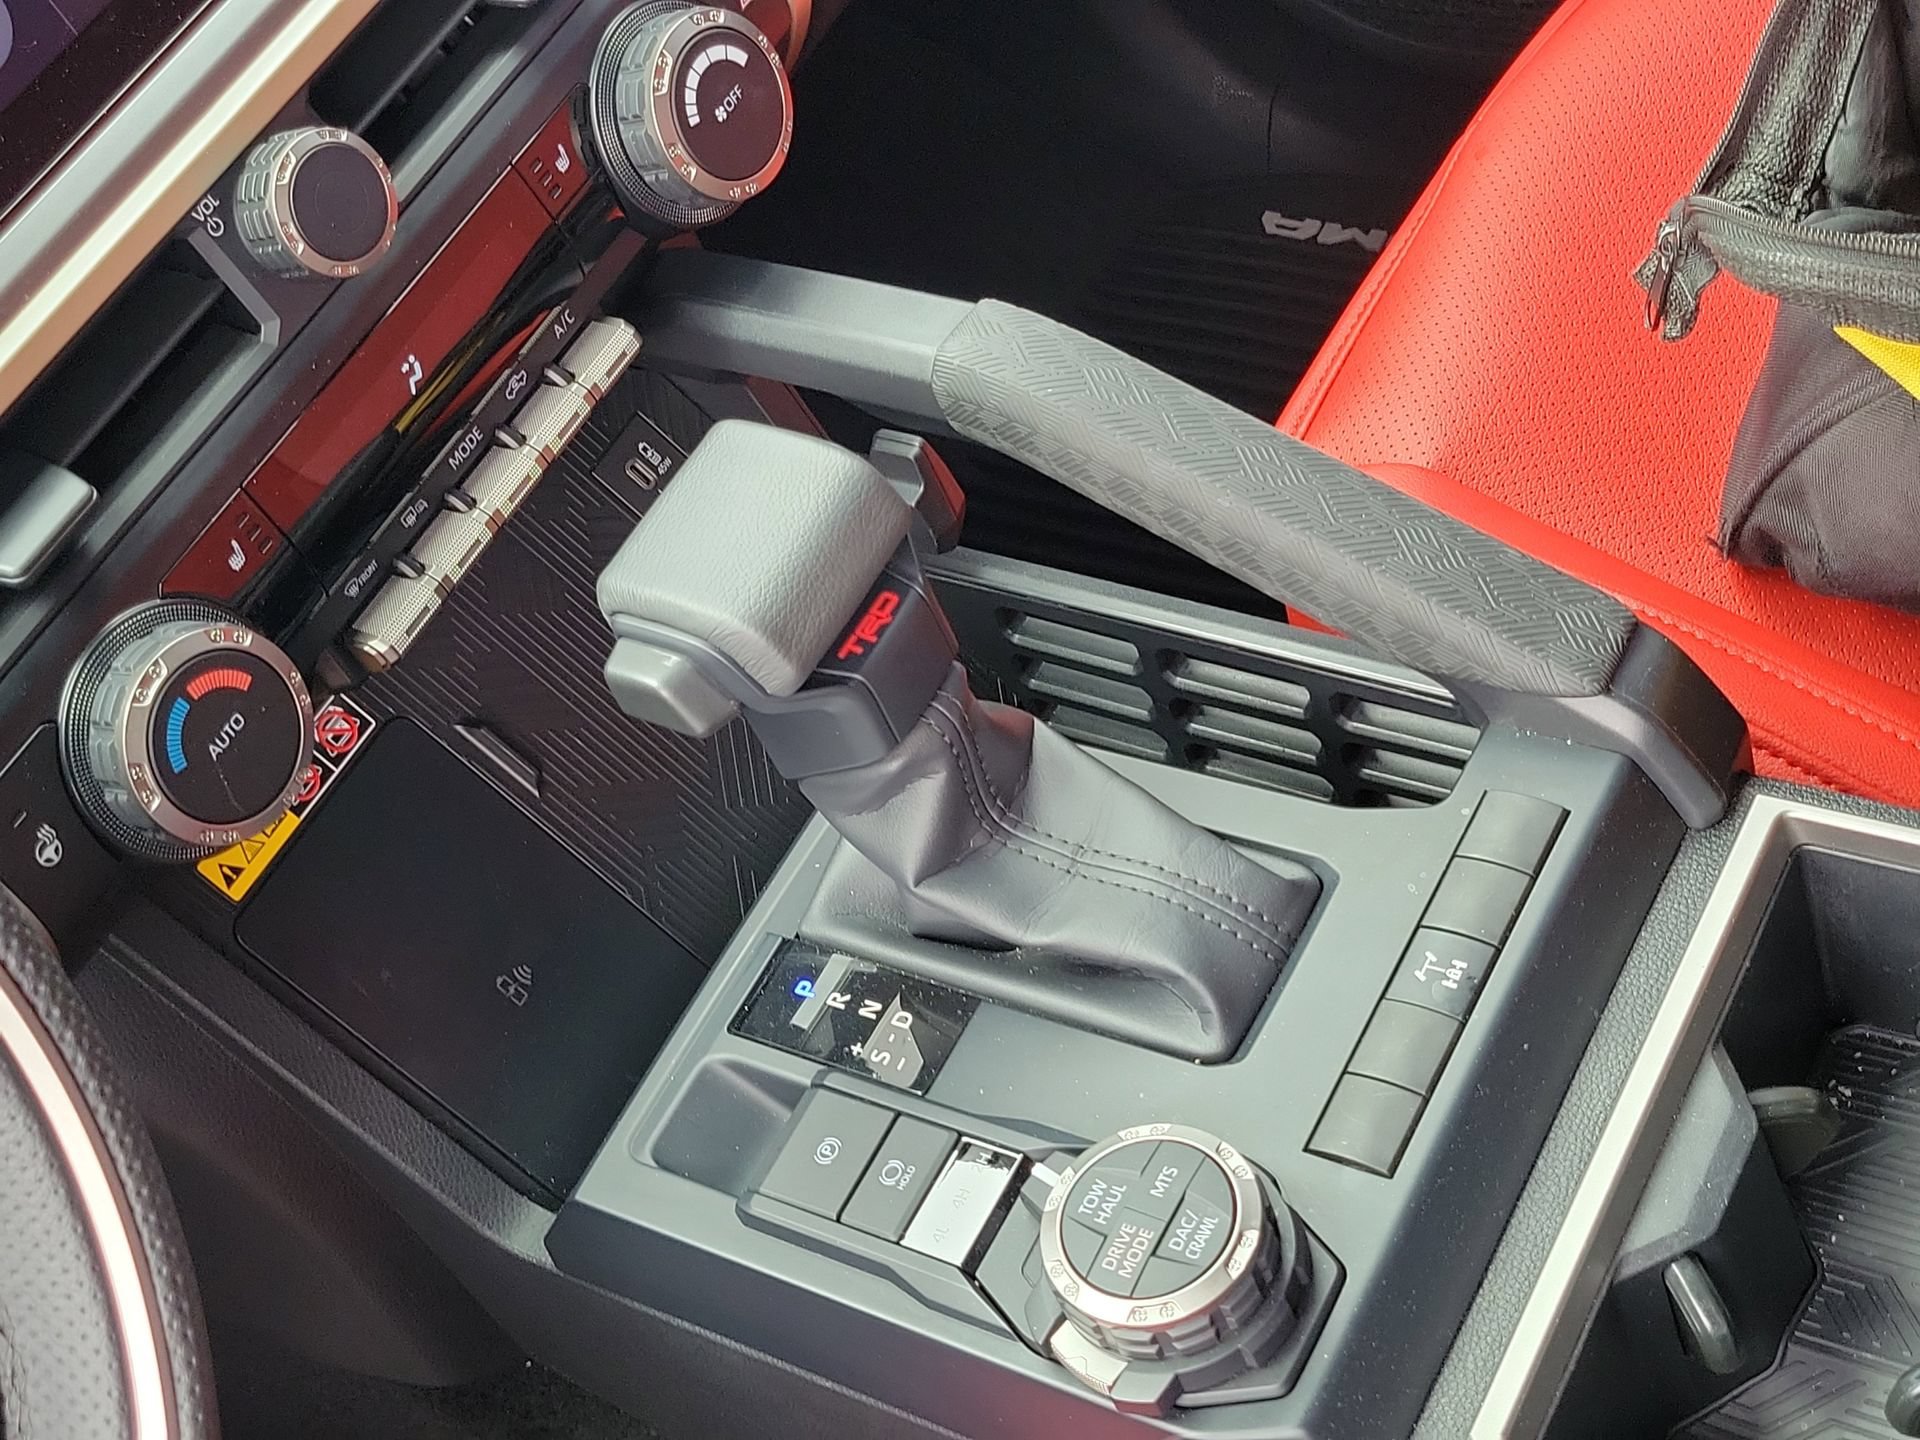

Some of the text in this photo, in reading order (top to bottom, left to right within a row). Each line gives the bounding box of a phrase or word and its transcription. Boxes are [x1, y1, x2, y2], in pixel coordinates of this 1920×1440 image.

[722, 83, 744, 113] OFF
[190, 193, 220, 222] VOL
[553, 308, 576, 340] A/C
[447, 427, 484, 472] MODE
[357, 559, 379, 588] FRONT
[836, 589, 900, 660] TRD
[208, 712, 246, 762] AUTO
[794, 979, 818, 999] P
[825, 991, 852, 1011] R
[857, 999, 884, 1021] N
[890, 1010, 914, 1030] D
[869, 1048, 892, 1067] S
[895, 1164, 917, 1191] HOLD
[1149, 1165, 1180, 1198] MTS
[1077, 1178, 1109, 1216] TOW
[1093, 1182, 1128, 1225] HAUL
[1167, 1208, 1200, 1252] DAC/
[1184, 1215, 1220, 1261] CRAWL
[1101, 1221, 1138, 1272] DRIVE
[1117, 1227, 1155, 1279] MODE
